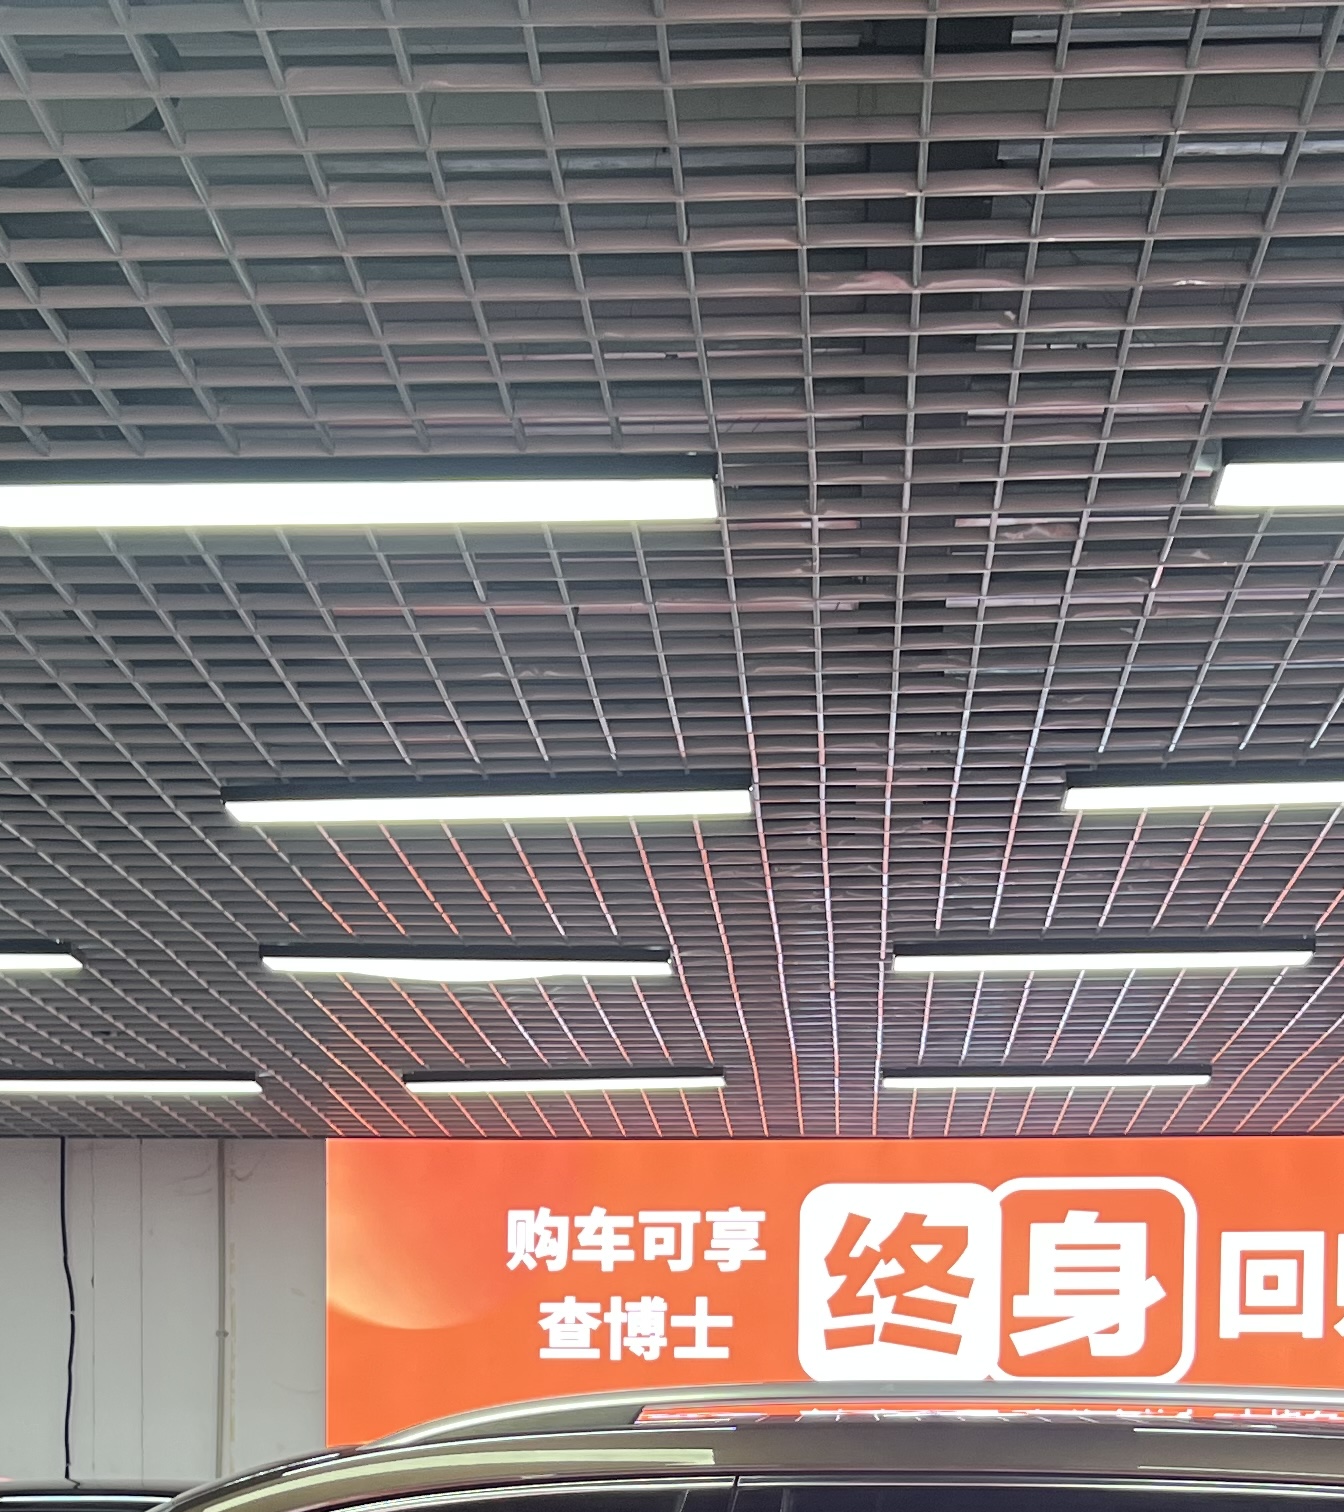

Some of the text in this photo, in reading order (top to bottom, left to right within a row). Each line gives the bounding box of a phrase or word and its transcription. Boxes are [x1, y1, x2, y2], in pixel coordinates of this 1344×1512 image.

[506, 1206, 768, 1273] 购车可享
[823, 1210, 1168, 1358] 终身
[537, 1294, 735, 1362] 查博士
